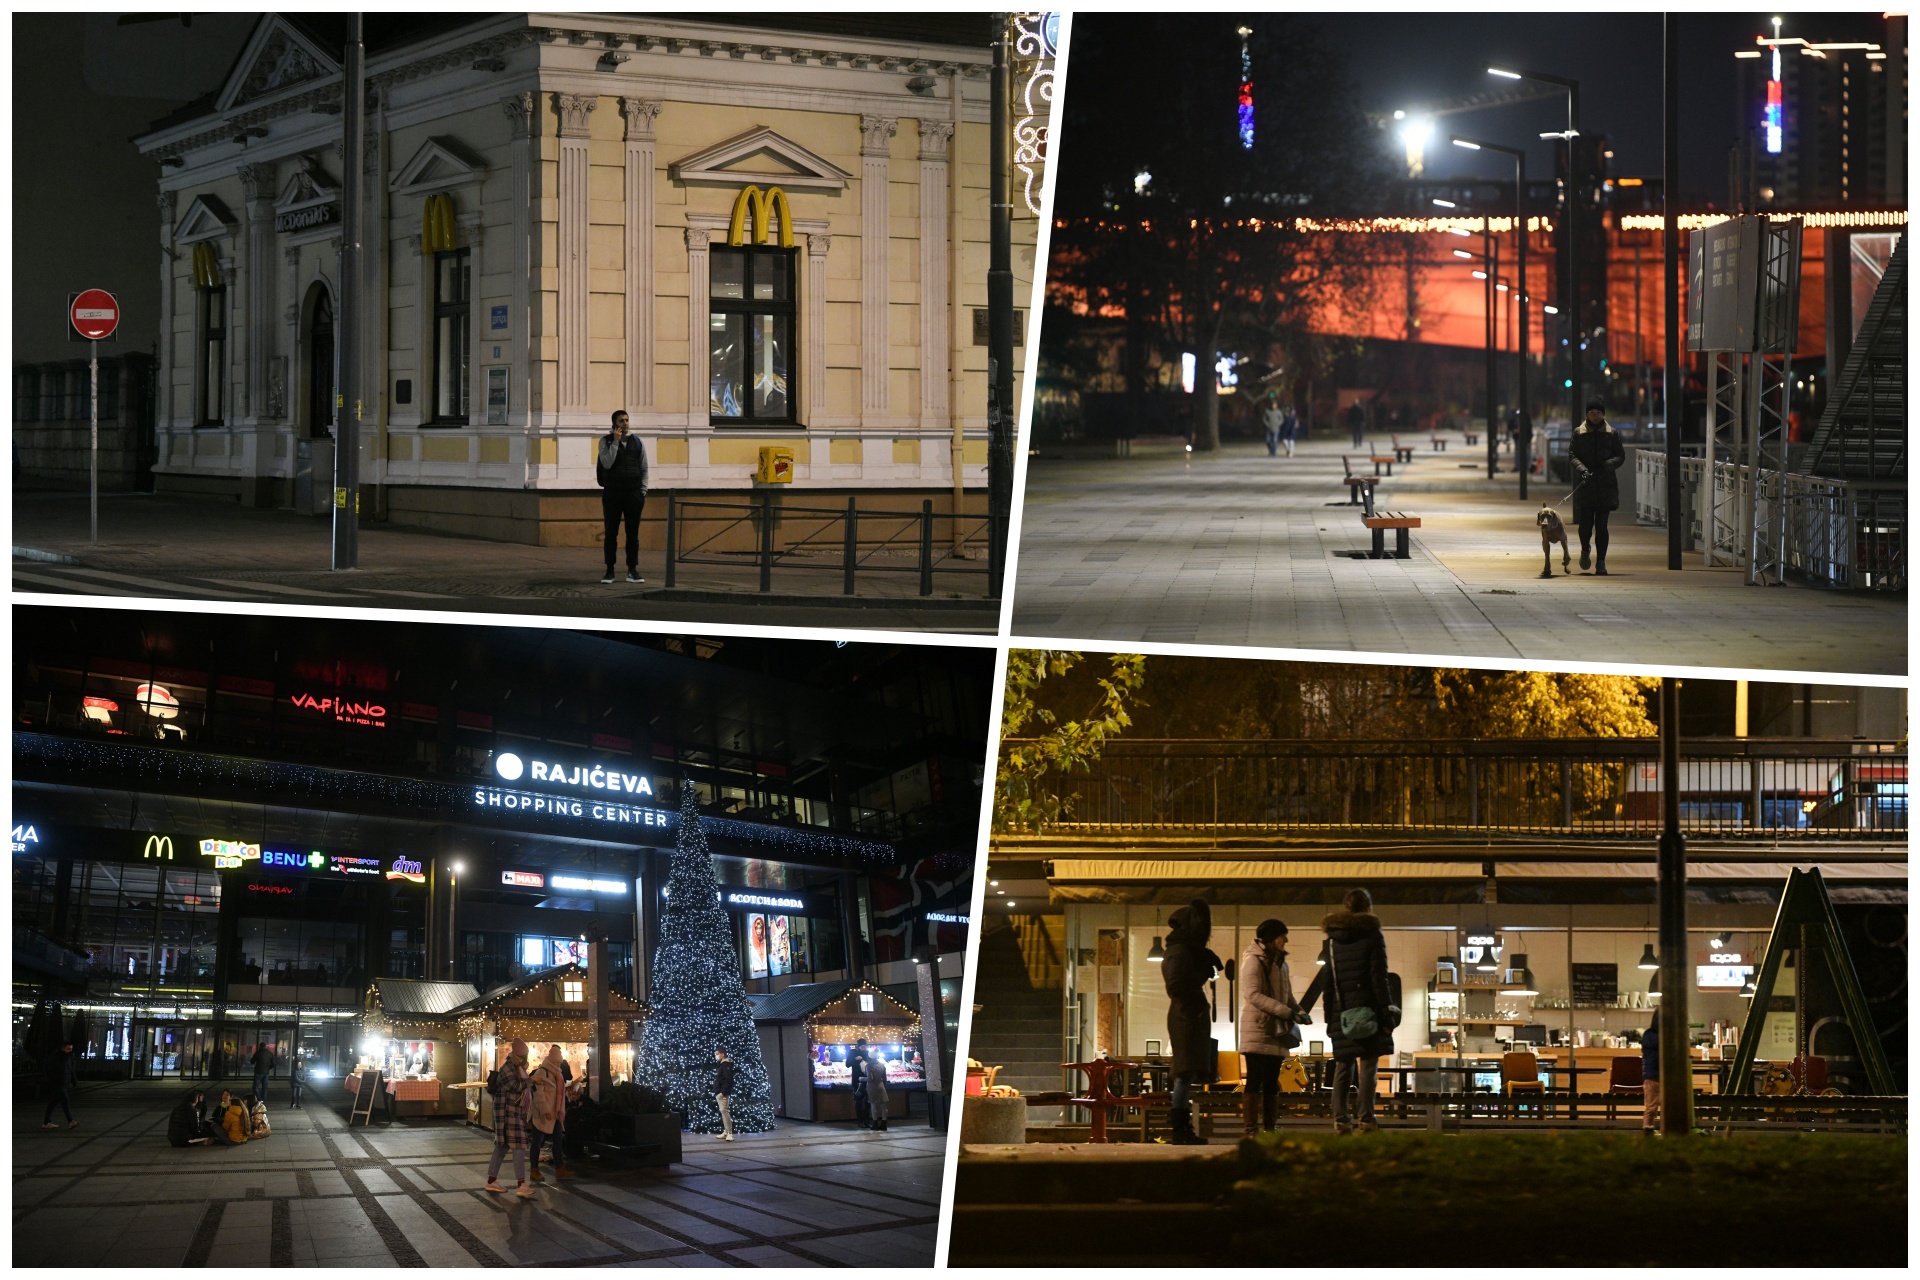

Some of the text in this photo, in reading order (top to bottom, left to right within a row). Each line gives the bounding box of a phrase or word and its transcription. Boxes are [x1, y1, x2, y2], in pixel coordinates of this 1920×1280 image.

[336, 715, 352, 723] PATA
[531, 760, 653, 796] RAJIĆEVA
[475, 791, 667, 828] SHOPPING CENTER
[203, 841, 257, 857] DEXY CO
[263, 851, 307, 867] BENU
[337, 856, 380, 867] INTERSPORT
[392, 854, 422, 874] dm
[516, 873, 542, 885] MAXI
[728, 892, 804, 909] SCOTCH&SODA
